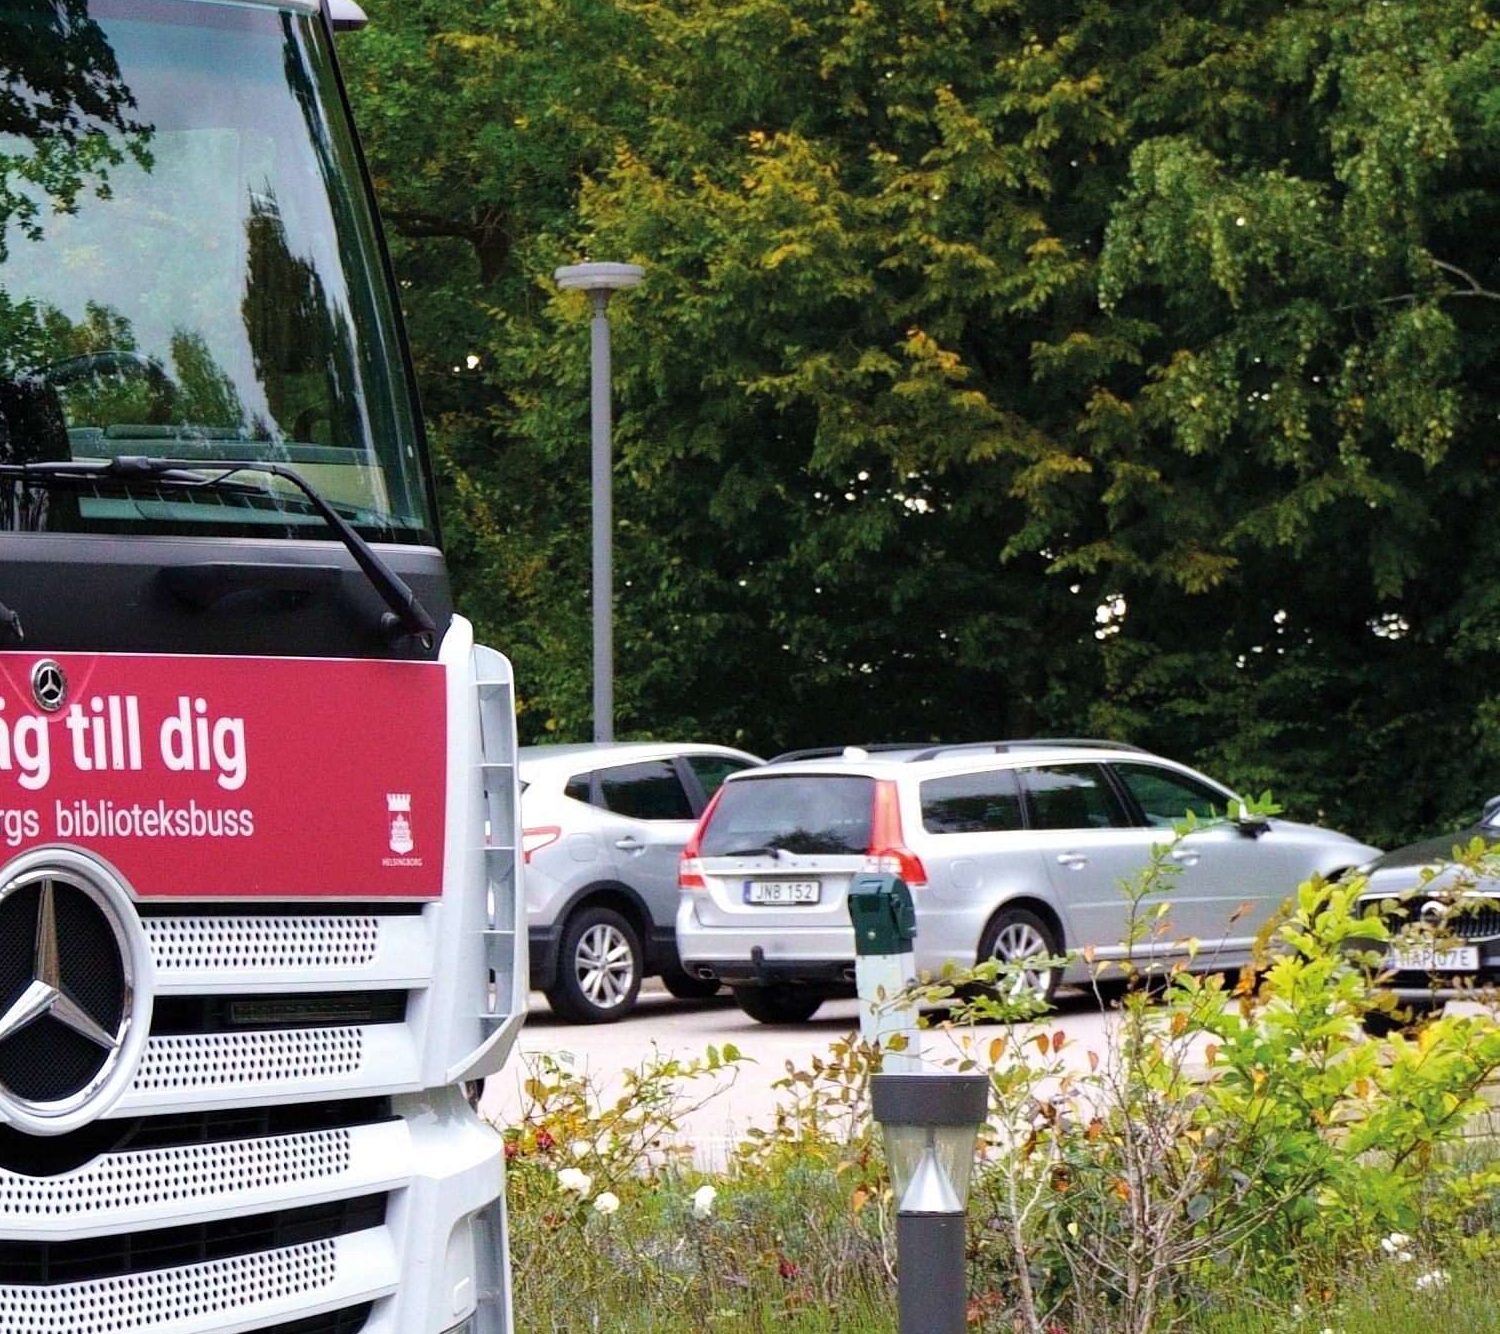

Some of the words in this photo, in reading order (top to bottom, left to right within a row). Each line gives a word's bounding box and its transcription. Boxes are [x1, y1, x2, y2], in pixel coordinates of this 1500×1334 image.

[66, 695, 142, 771] till
[159, 696, 248, 791] dig
[55, 799, 255, 838] biblioteksbuss
[381, 858, 423, 867] HELSINGBORG
[756, 884, 782, 900] JNB
[787, 884, 813, 899] 152
